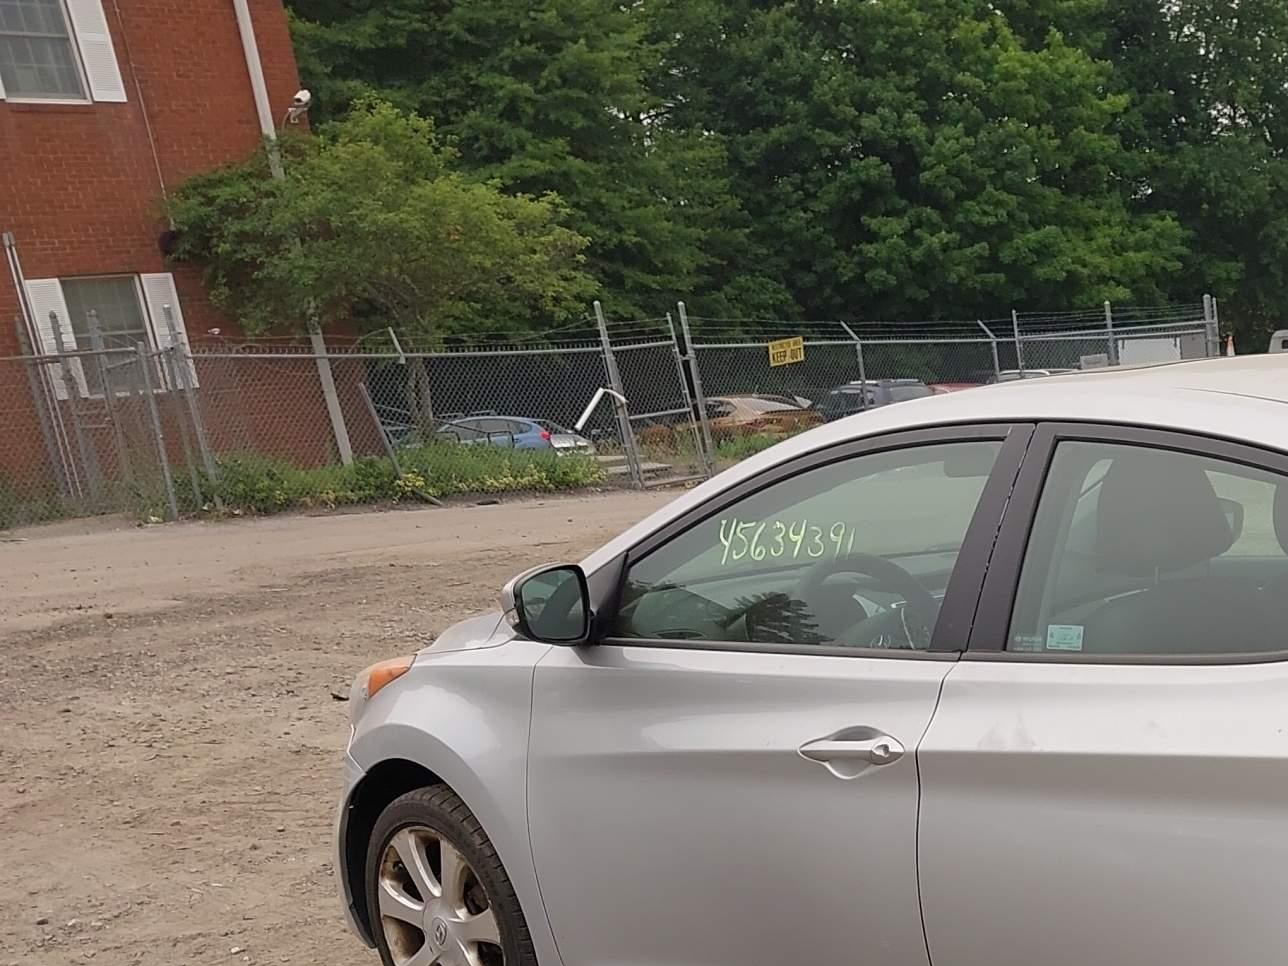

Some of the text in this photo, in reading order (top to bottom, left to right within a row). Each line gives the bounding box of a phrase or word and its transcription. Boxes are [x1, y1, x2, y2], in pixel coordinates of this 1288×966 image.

[772, 348, 802, 363] KEEP OUT
[719, 517, 857, 566] 45634391
